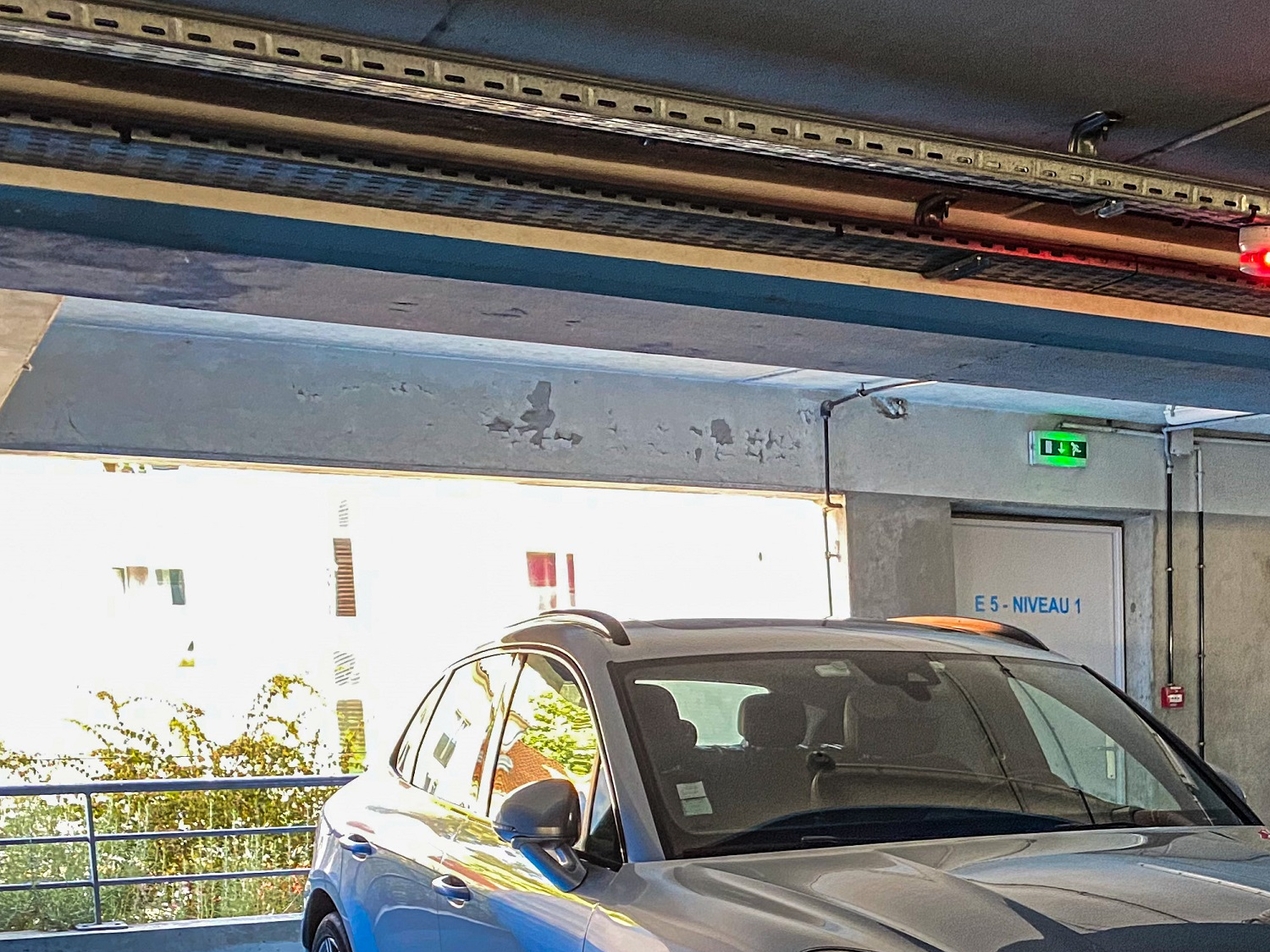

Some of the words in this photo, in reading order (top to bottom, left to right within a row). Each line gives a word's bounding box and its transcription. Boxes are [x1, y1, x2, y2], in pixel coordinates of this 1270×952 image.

[975, 595, 985, 612] E
[990, 595, 999, 612] 5
[1013, 596, 1069, 614] NIVEAU
[1075, 597, 1081, 614] 1
